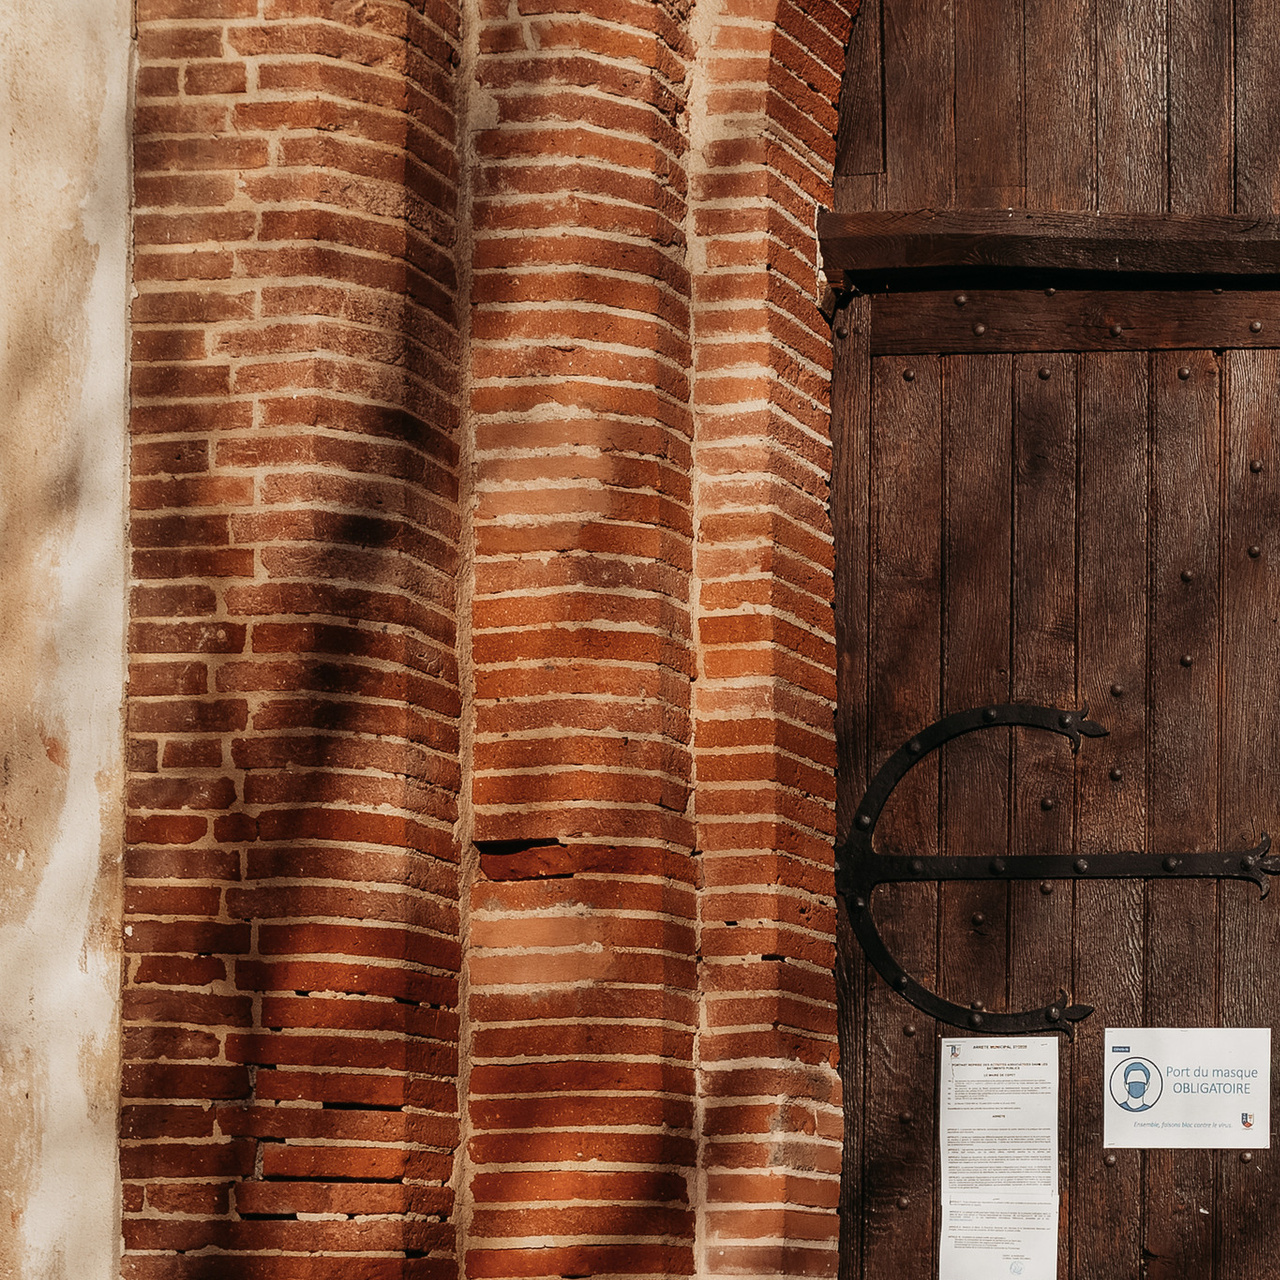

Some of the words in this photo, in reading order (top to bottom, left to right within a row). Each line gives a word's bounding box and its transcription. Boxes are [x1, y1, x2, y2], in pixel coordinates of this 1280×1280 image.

[1166, 1066, 1190, 1078] Port
[1193, 1066, 1208, 1078] du
[1212, 1068, 1258, 1082] masque
[1173, 1082, 1251, 1094] OBLIGATOIRE
